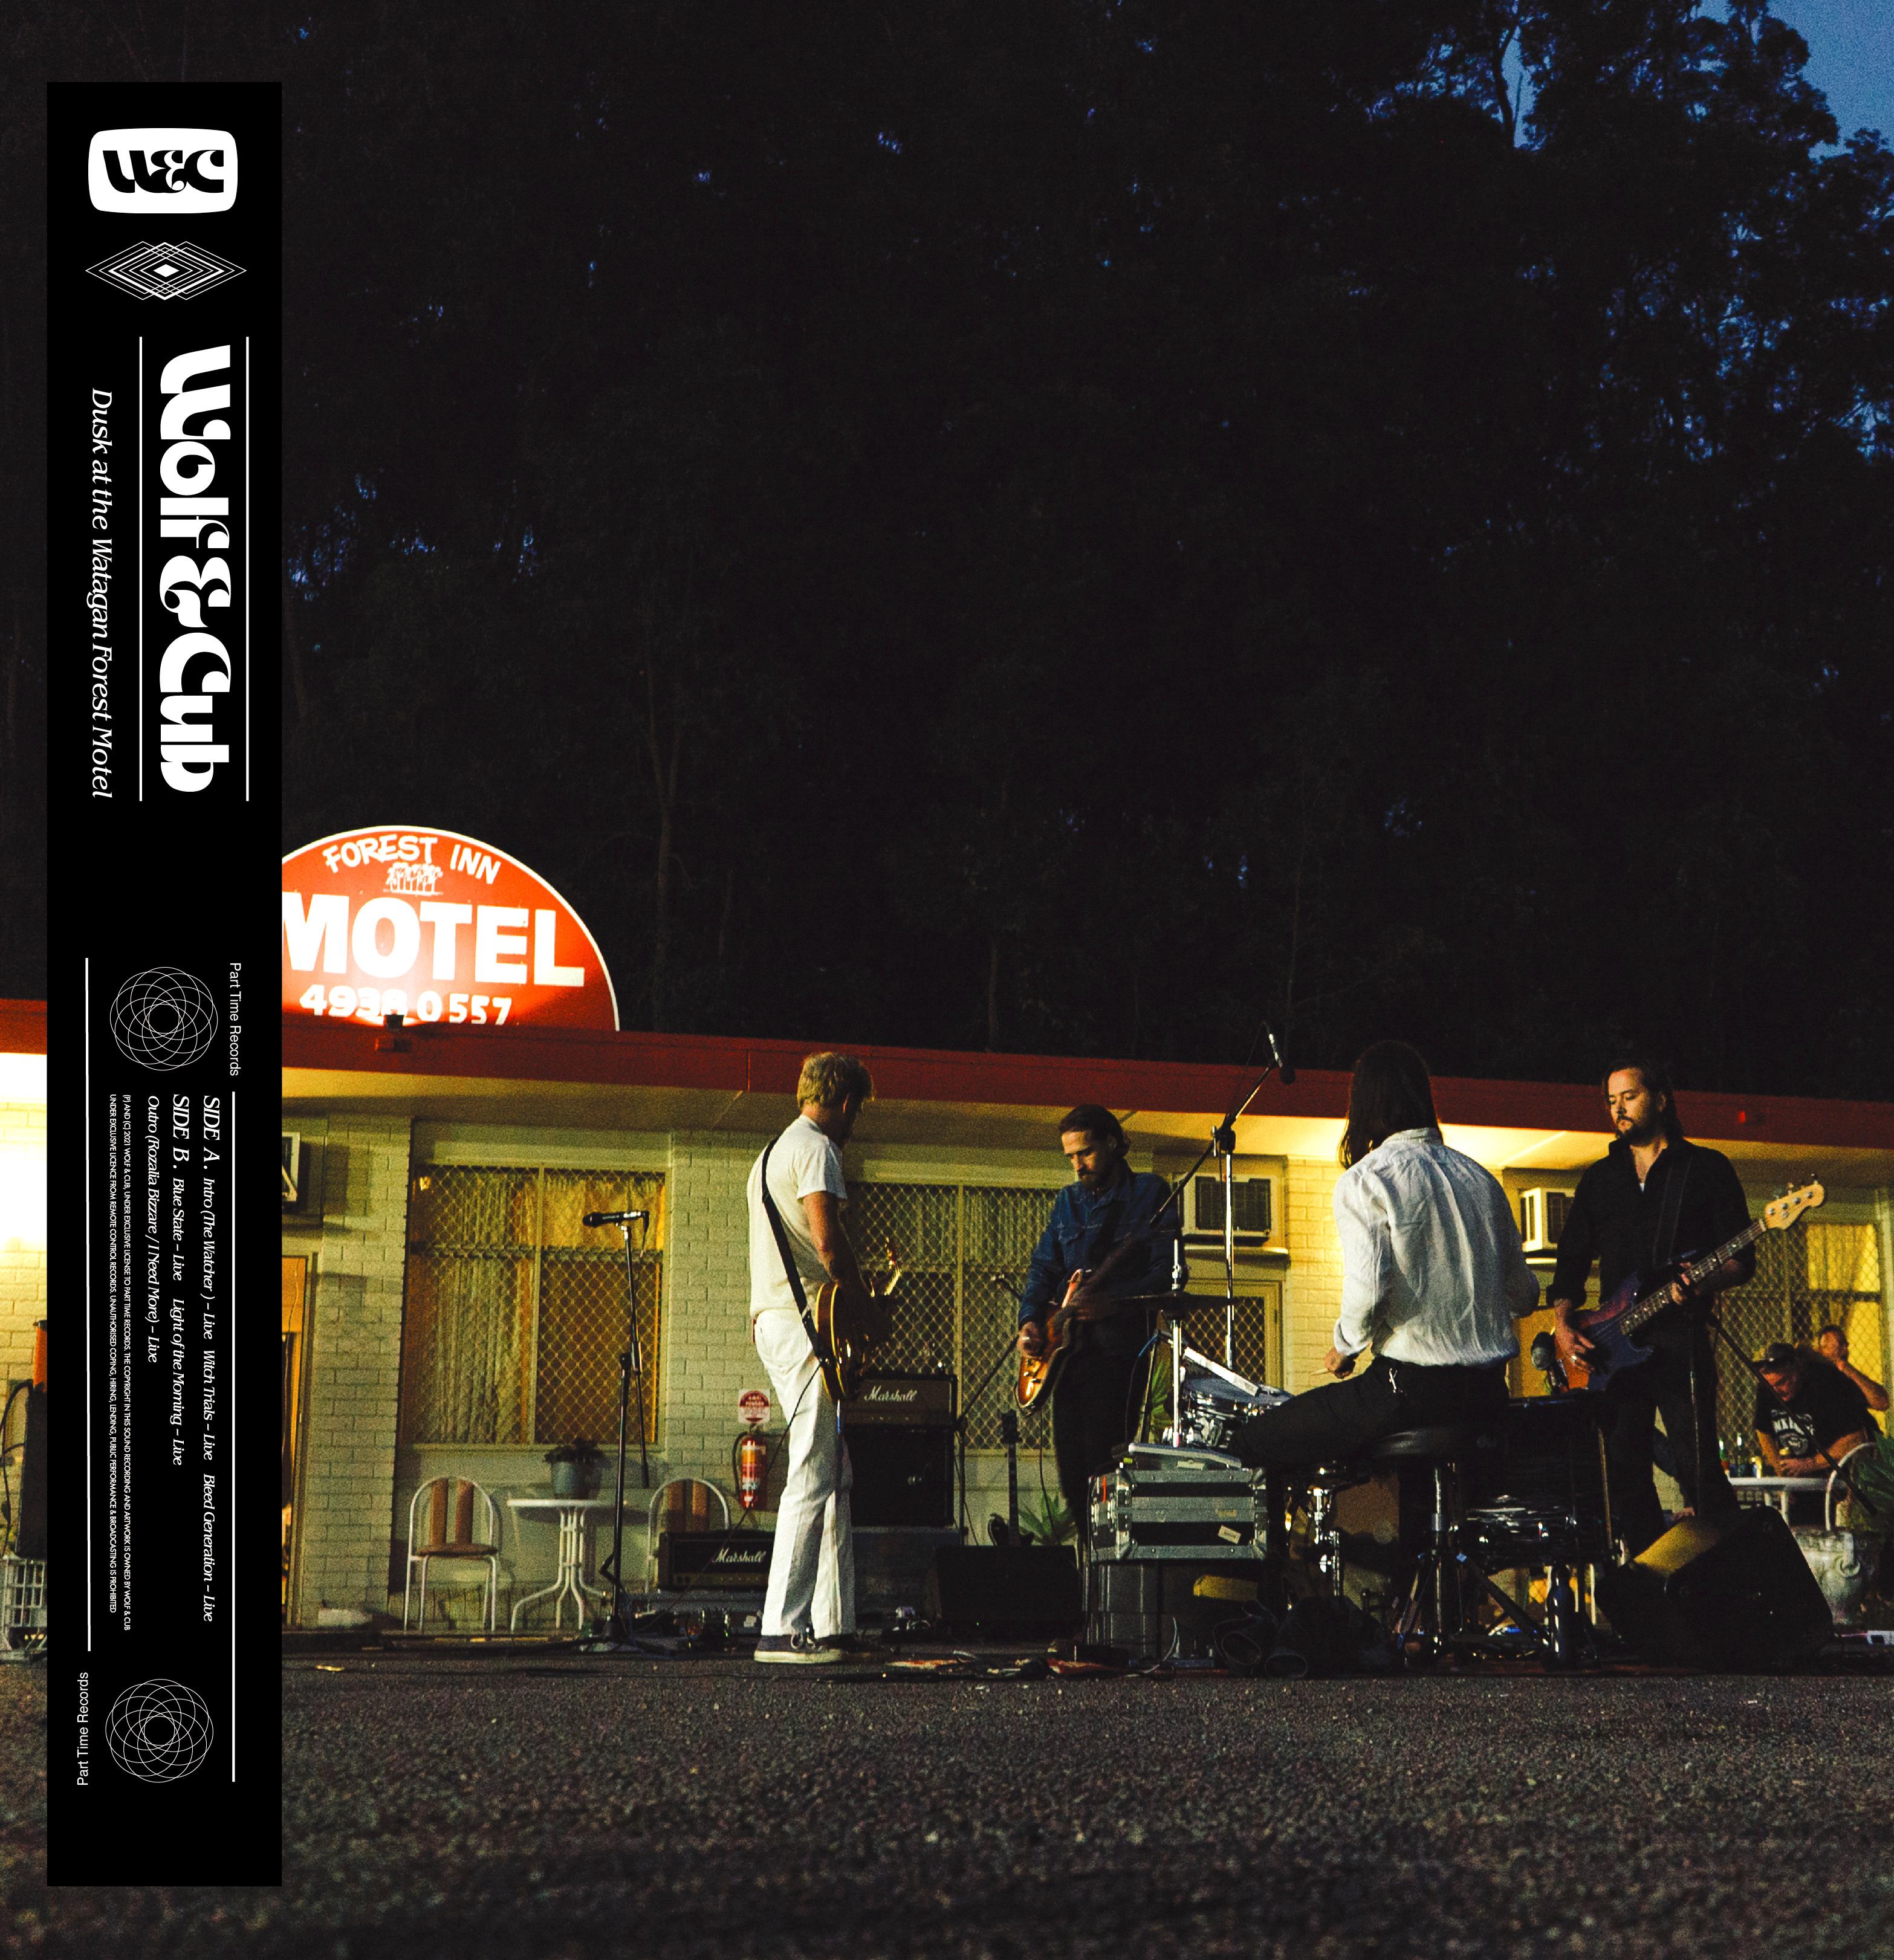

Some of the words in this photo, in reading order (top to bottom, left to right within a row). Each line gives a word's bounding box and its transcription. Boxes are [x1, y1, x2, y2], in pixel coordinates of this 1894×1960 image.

[322, 834, 438, 873] FOREST
[450, 844, 501, 884] INN
[282, 891, 585, 988] MOTEL
[864, 1385, 918, 1402] Marshall
[712, 1547, 767, 1563] Marshall
